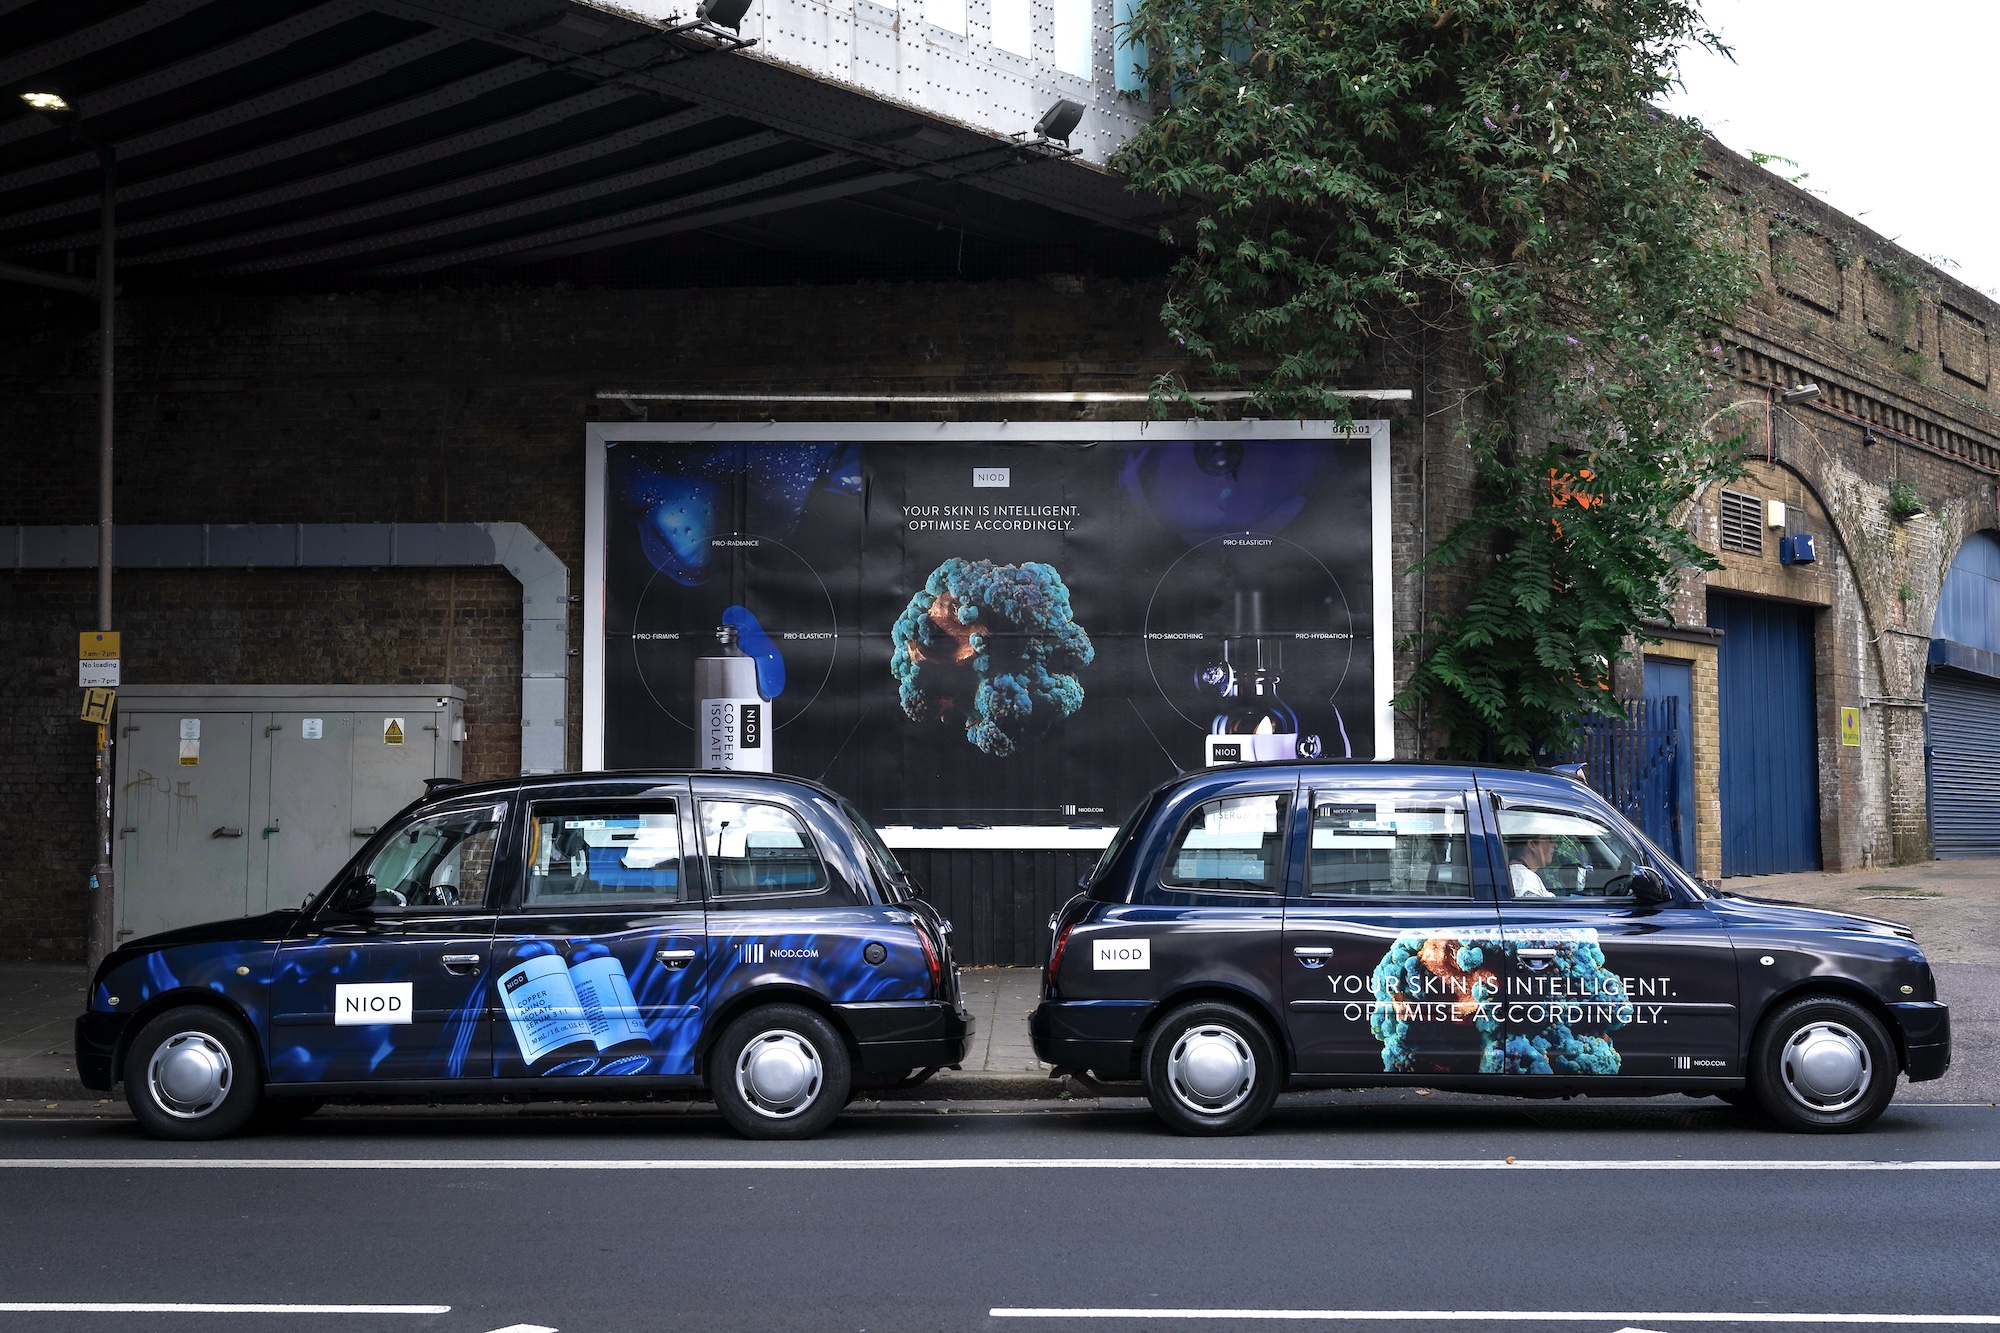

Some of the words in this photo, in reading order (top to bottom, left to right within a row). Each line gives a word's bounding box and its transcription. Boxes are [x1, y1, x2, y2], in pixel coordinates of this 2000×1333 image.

[978, 473, 1005, 482] NIOD
[902, 505, 940, 517] YOUR
[943, 505, 974, 517] SKIN
[978, 505, 990, 517] IS
[994, 505, 1081, 517] INTELLIGENT.
[908, 520, 971, 531] OPTIMISE
[974, 520, 1075, 531] ACCORDINGLY.
[86, 689, 110, 720] H
[711, 704, 721, 761] ISOLATE
[724, 703, 734, 761] COPPER
[746, 710, 756, 743] NIOD
[769, 949, 819, 958] NIOD.COM
[1100, 948, 1142, 961] NIOD
[507, 975, 524, 990] NIOD
[1327, 974, 1400, 995] YOUR
[1409, 975, 1468, 995] SKIN
[1478, 975, 1498, 995] IS
[1507, 976, 1678, 997] INTELLIGENT.
[345, 996, 402, 1012] NIOD
[517, 990, 547, 1009] COPPER
[520, 999, 546, 1016] AMINO
[522, 1004, 553, 1022] ISOLATE
[1343, 1003, 1463, 1024] OPTIMISE
[1471, 1004, 1669, 1025] ACCORDINGLY.
[525, 1015, 551, 1031] SERUM
